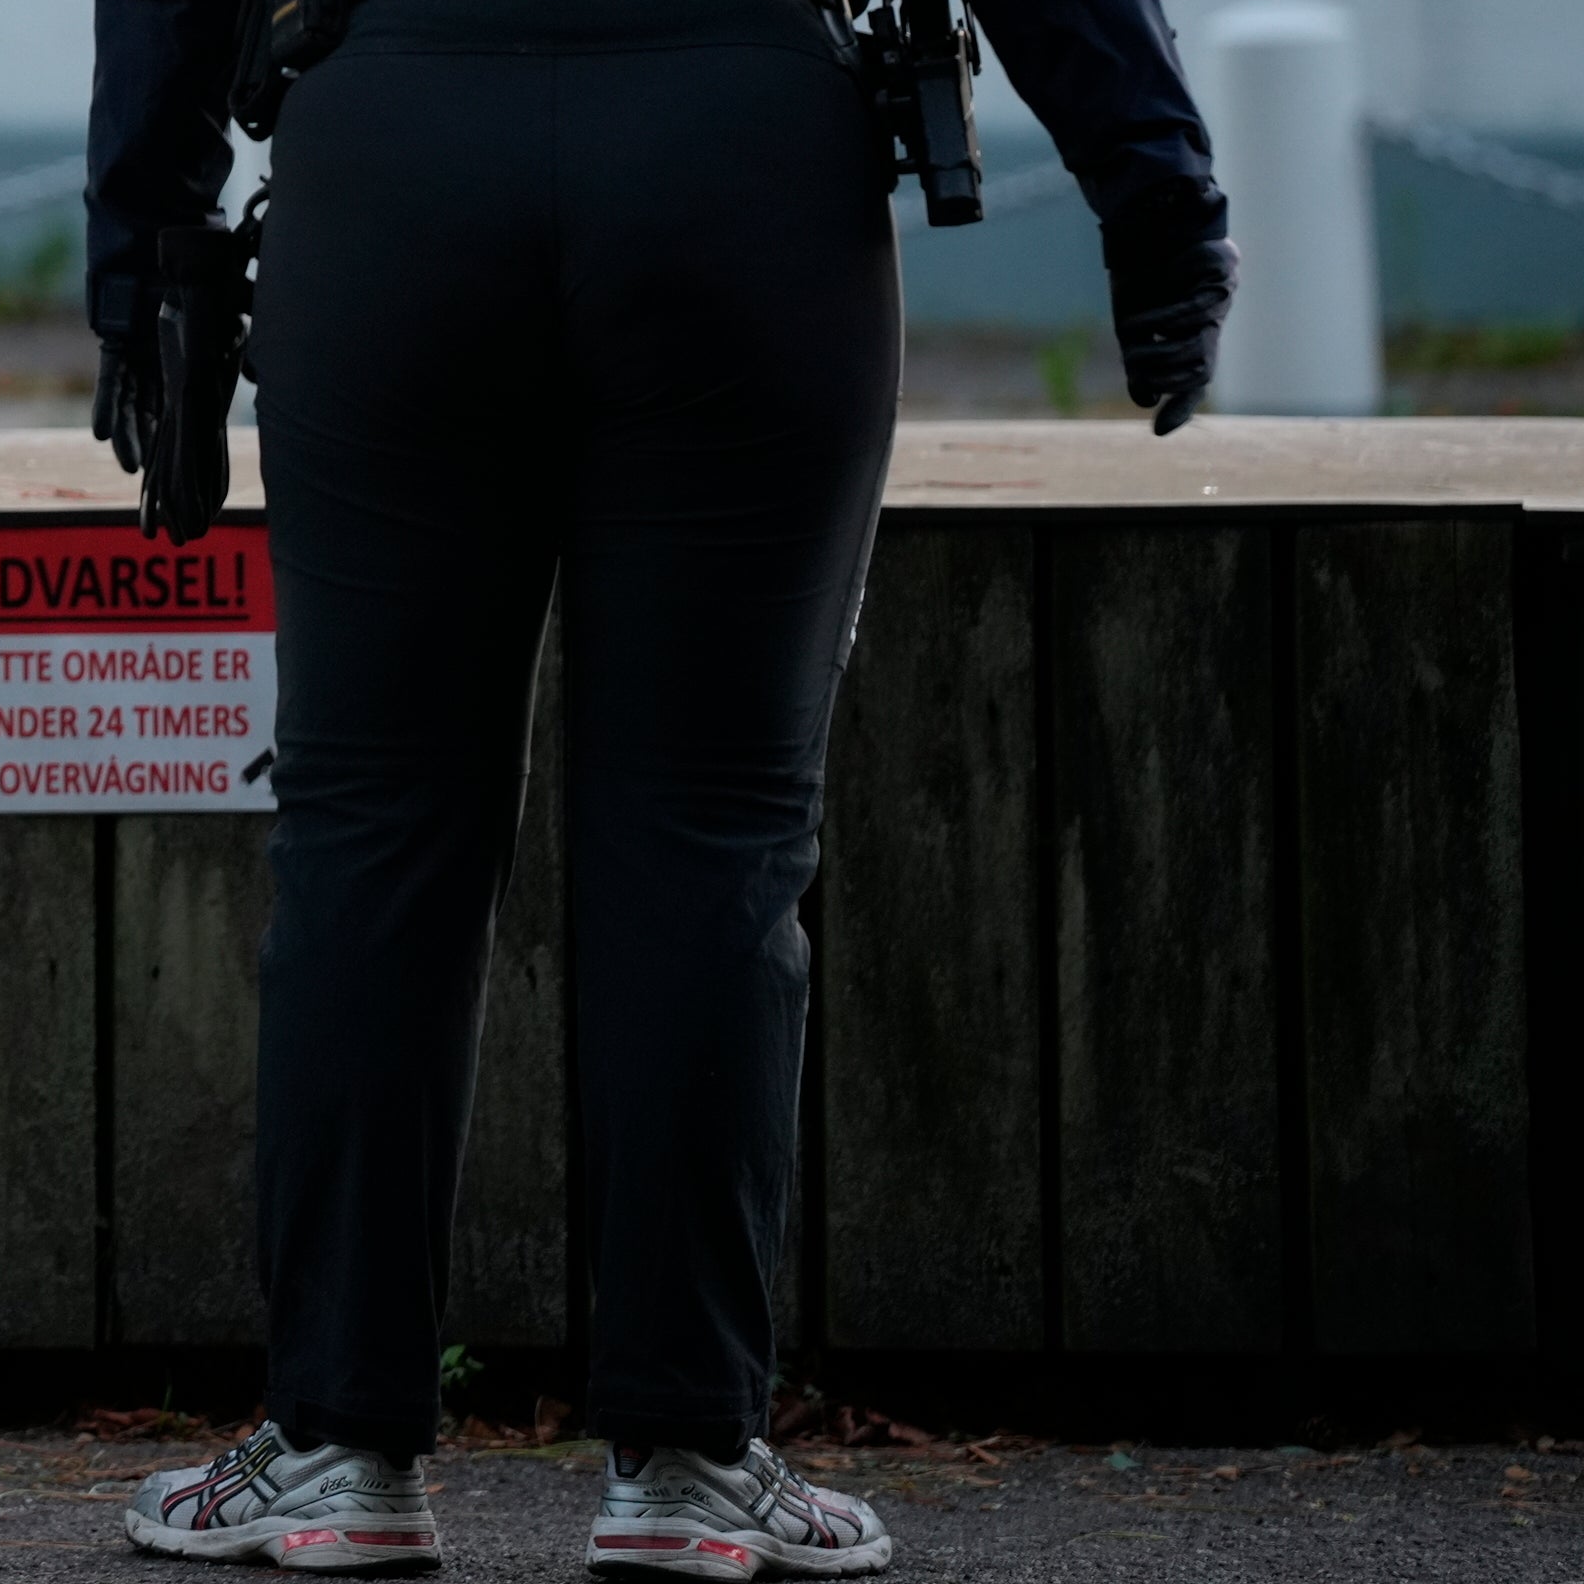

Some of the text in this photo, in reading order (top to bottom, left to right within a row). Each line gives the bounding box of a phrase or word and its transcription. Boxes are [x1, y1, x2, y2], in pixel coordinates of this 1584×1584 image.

[62, 643, 203, 682] OMRÅDE
[213, 648, 251, 681] ER
[87, 707, 124, 738] 24
[135, 705, 250, 737] TIMERS
